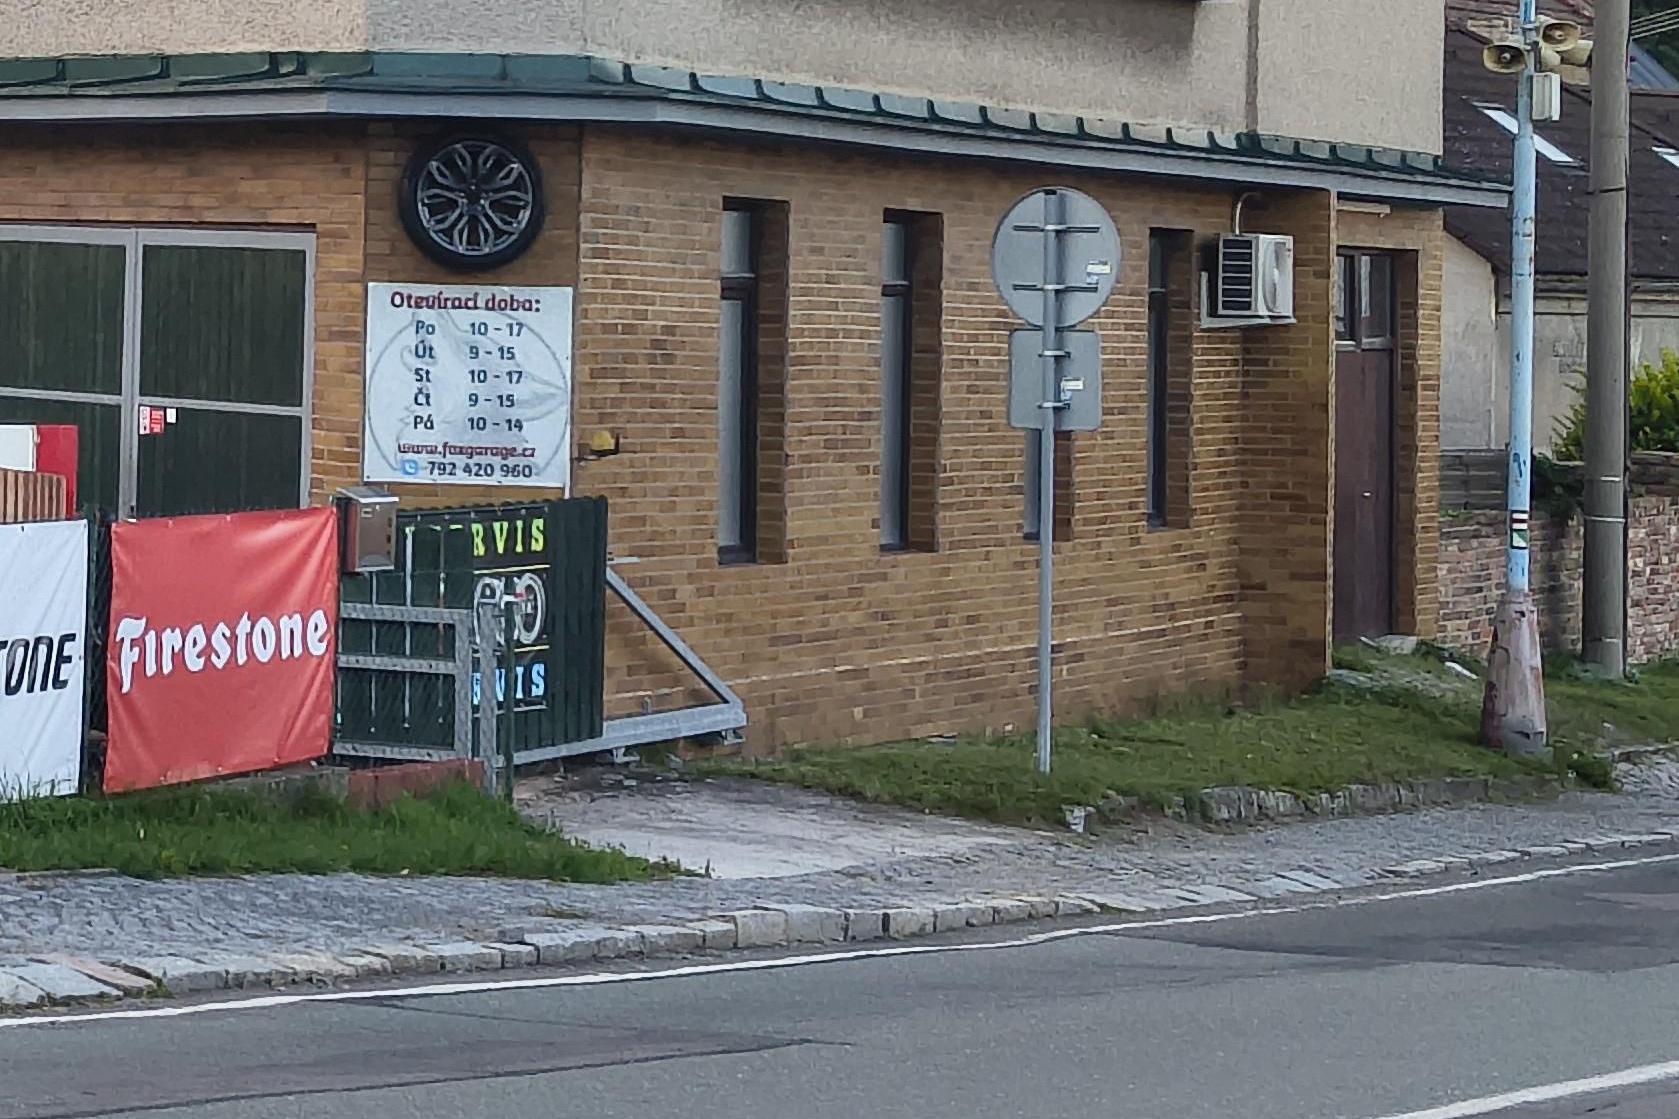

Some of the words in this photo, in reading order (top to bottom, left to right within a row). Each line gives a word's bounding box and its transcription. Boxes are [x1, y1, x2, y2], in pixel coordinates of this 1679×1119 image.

[484, 293, 541, 312] doba:
[415, 319, 436, 336] Po
[470, 321, 489, 336] 10
[506, 322, 525, 337] 17
[414, 339, 435, 360] Út
[469, 345, 480, 360] 9
[497, 346, 516, 360] 15
[413, 368, 431, 384] St
[468, 369, 488, 384] 10
[505, 370, 523, 385] 17
[413, 387, 431, 407] Čt
[468, 392, 479, 407] 9
[497, 393, 515, 408] 15
[413, 414, 435, 431] Pá
[468, 417, 487, 431] 10
[505, 417, 524, 432] 14
[427, 461, 457, 477] 792
[462, 463, 495, 478] 420
[500, 463, 533, 479] 960
[115, 608, 329, 694] Firestone
